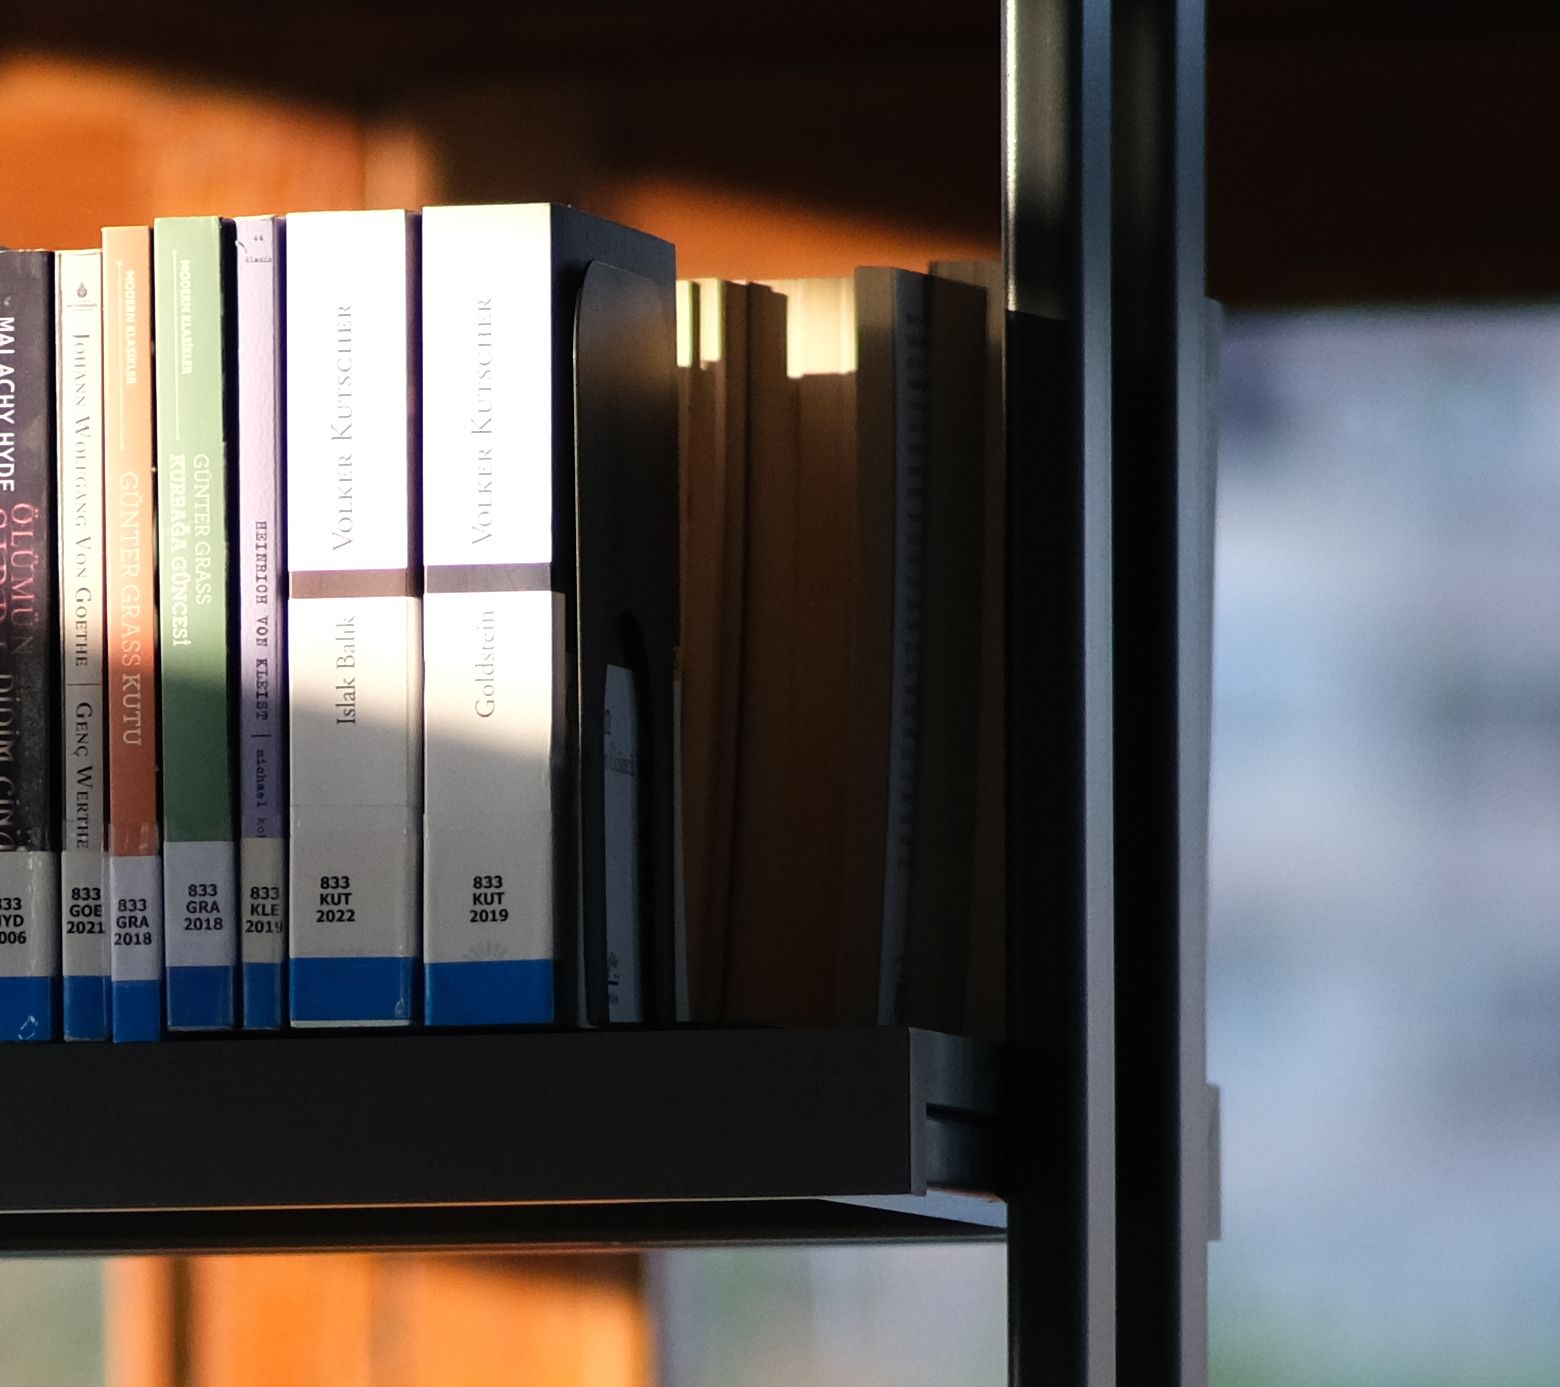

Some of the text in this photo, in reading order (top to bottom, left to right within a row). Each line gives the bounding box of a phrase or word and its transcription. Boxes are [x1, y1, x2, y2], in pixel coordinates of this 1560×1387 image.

[170, 454, 192, 646] KURBAĞA GÜNCESİ
[193, 453, 213, 605] GÜNTER GRASS
[474, 609, 497, 718] Goldstein
[472, 891, 505, 906] KUT
[473, 876, 503, 889] 833
[469, 909, 508, 922] 2019
